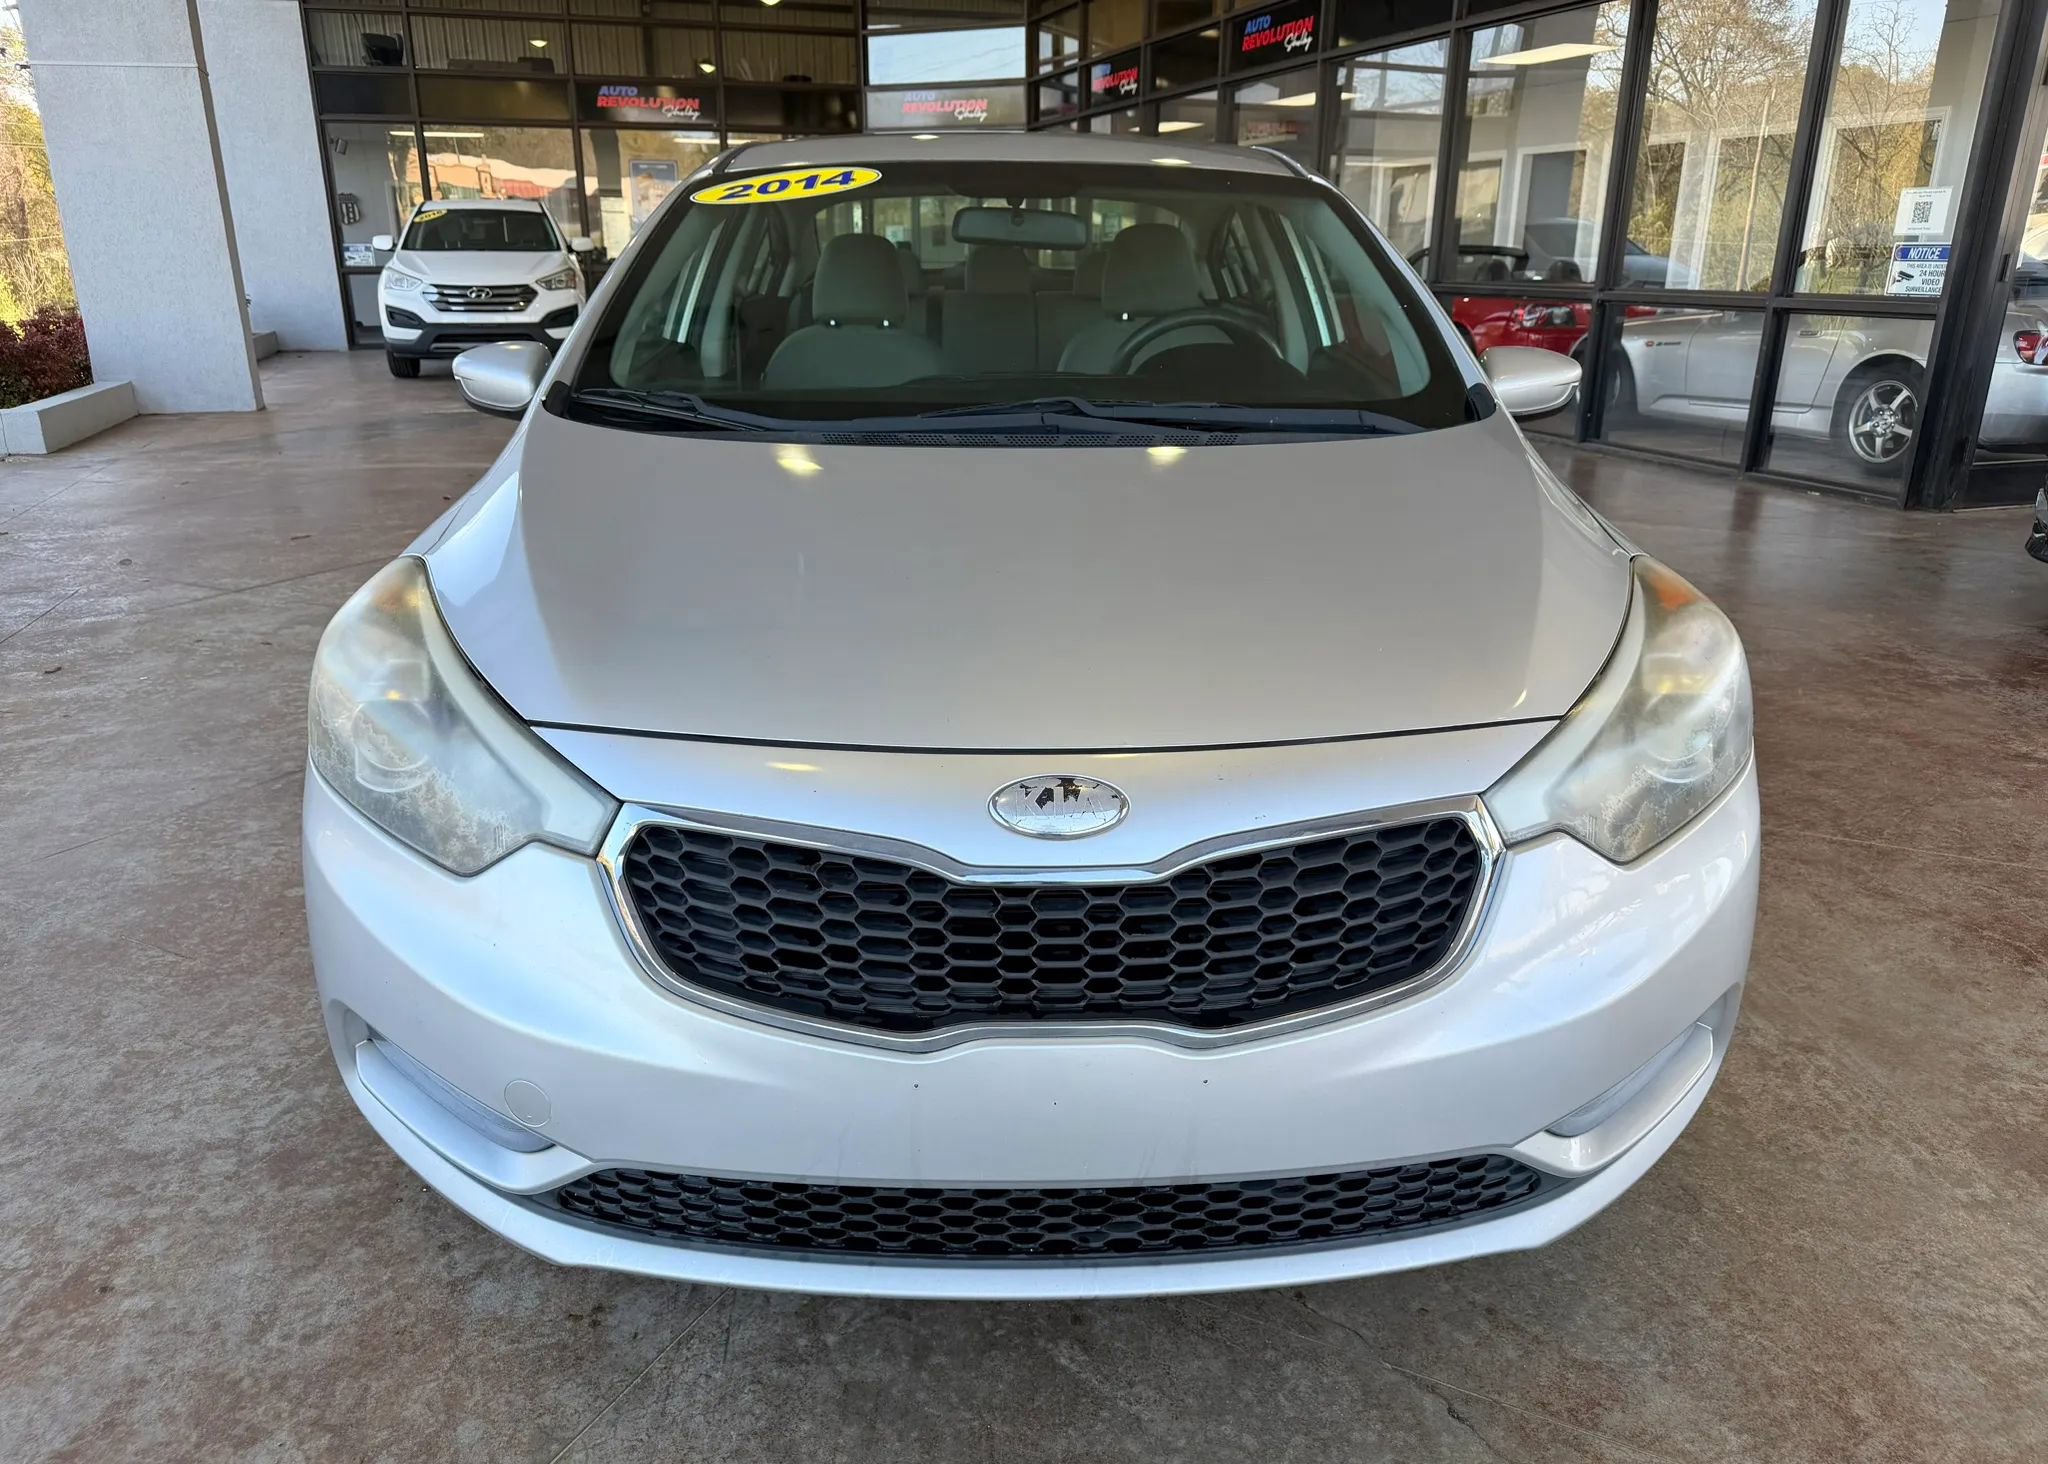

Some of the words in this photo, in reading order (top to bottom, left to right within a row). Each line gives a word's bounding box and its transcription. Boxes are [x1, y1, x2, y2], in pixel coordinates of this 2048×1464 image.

[1244, 15, 1271, 35] AUTO
[1242, 15, 1315, 52] REVOLUTION
[1284, 28, 1313, 52] Shelby
[1095, 65, 1138, 93] VOLUTION
[599, 85, 638, 96] AUTO
[904, 92, 936, 101] AUTO
[597, 96, 700, 109] REVOLUTION
[903, 99, 988, 113] REVOLUTION
[662, 105, 701, 120] Shelby
[954, 108, 988, 122] Shelby
[717, 170, 856, 201] 2014
[1907, 247, 1943, 259] NOTICE
[1928, 270, 1945, 278] HOUR
